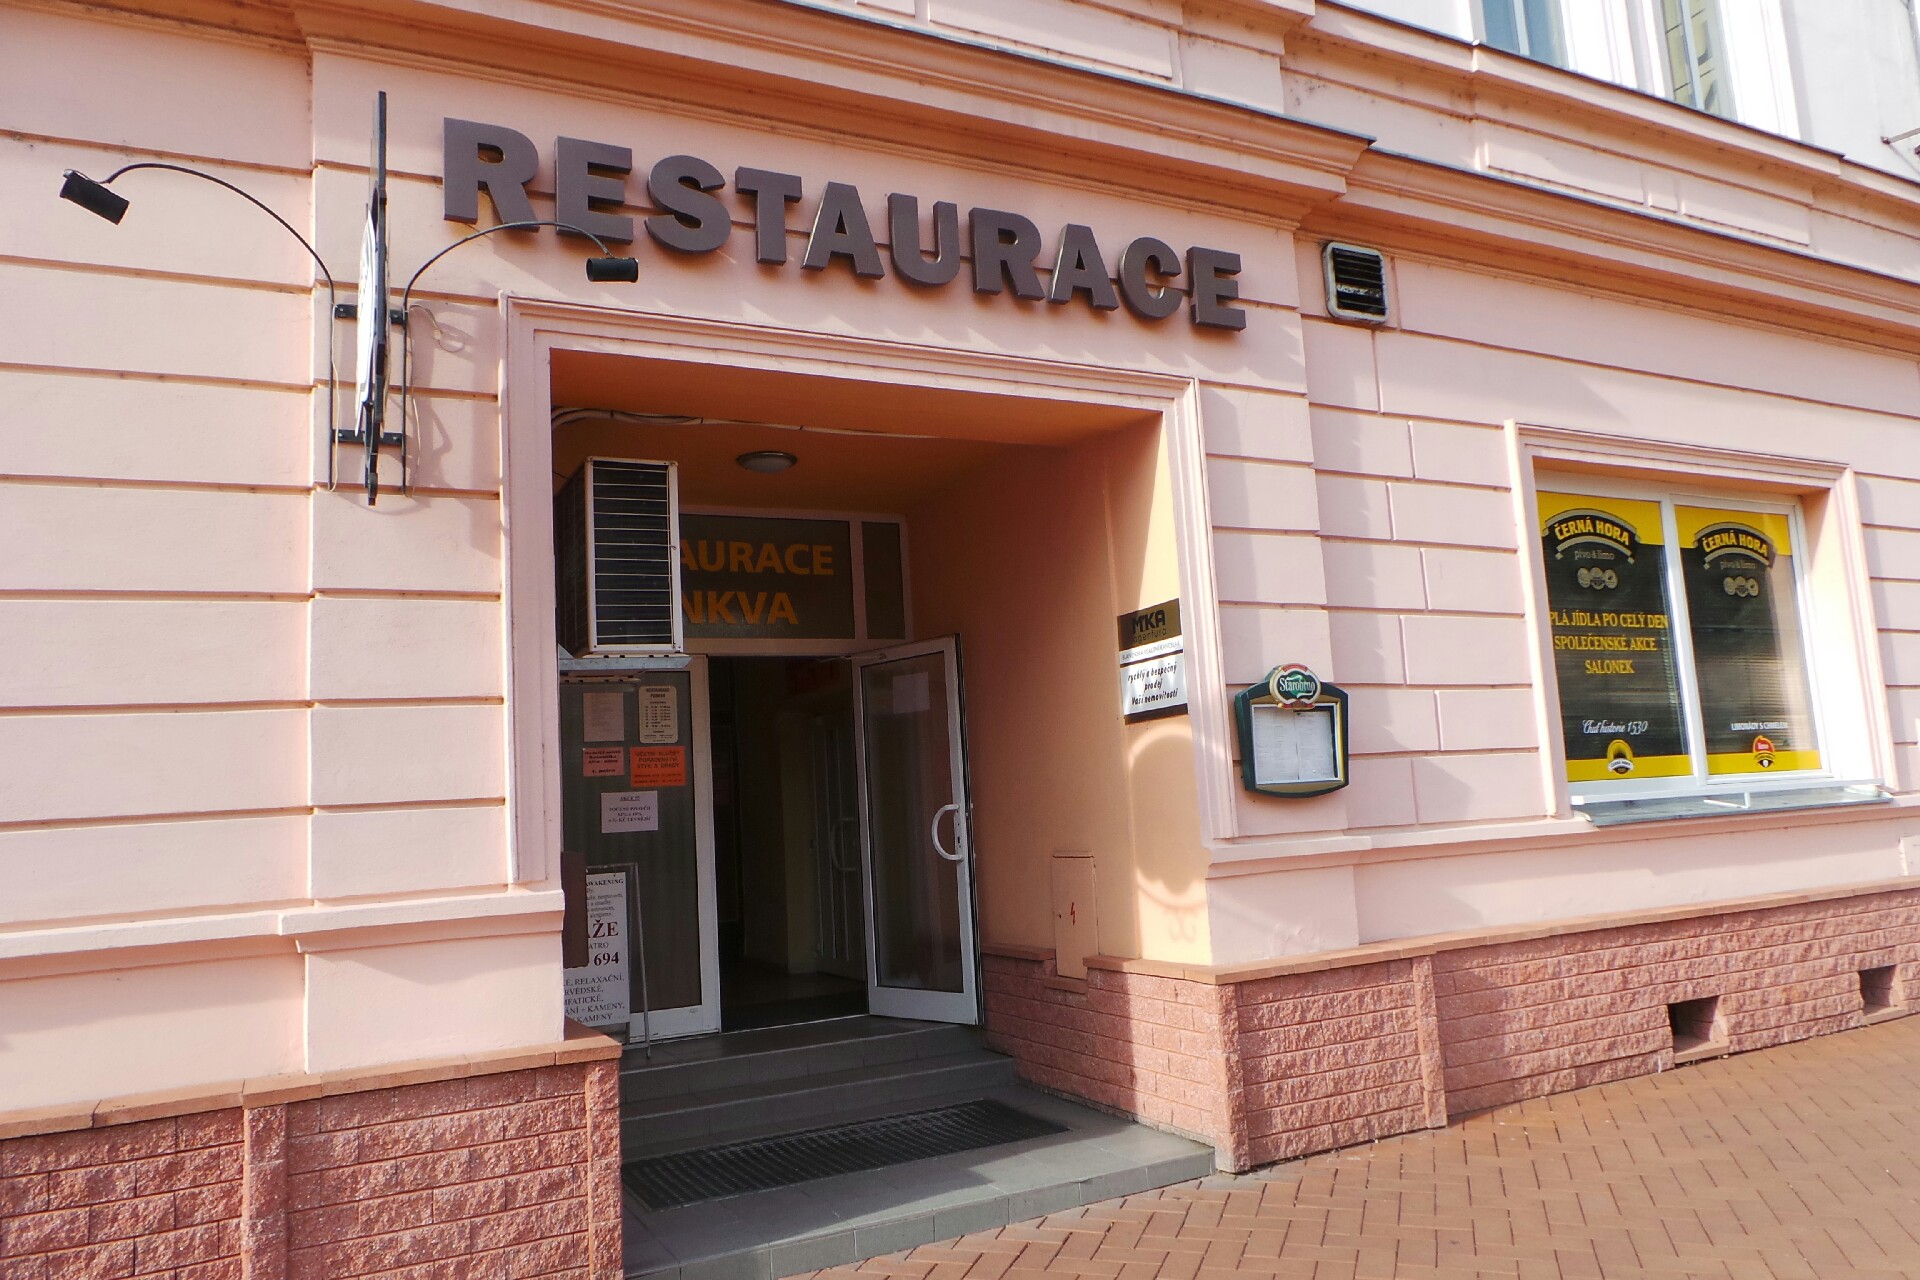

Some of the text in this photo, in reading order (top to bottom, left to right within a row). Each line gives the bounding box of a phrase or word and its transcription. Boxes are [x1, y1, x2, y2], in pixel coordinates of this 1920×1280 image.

[443, 116, 1247, 331] RESTAURACE
[1554, 516, 1630, 545] ČERNÁ HORA
[1702, 530, 1769, 556] ČERNÁ HORA
[680, 540, 834, 575] AURACE
[682, 590, 798, 625] NKVA
[1132, 609, 1166, 634] MKA
[1571, 609, 1602, 626] JÍDLA
[1602, 613, 1618, 627] PO
[1620, 611, 1646, 628] CELÝ
[1647, 614, 1669, 628] DEN
[1133, 628, 1167, 644] agentura
[1554, 633, 1658, 650] SPOLEČENSKÉ AKCE
[1151, 661, 1178, 677] bezpečný
[1585, 659, 1635, 674] SALONEK
[1143, 678, 1163, 693] prodej
[1600, 719, 1626, 733] historie
[1627, 720, 1648, 735] 1530
[586, 878, 624, 887] WAKENING
[587, 918, 619, 938] ŽE
[593, 951, 620, 967] 694
